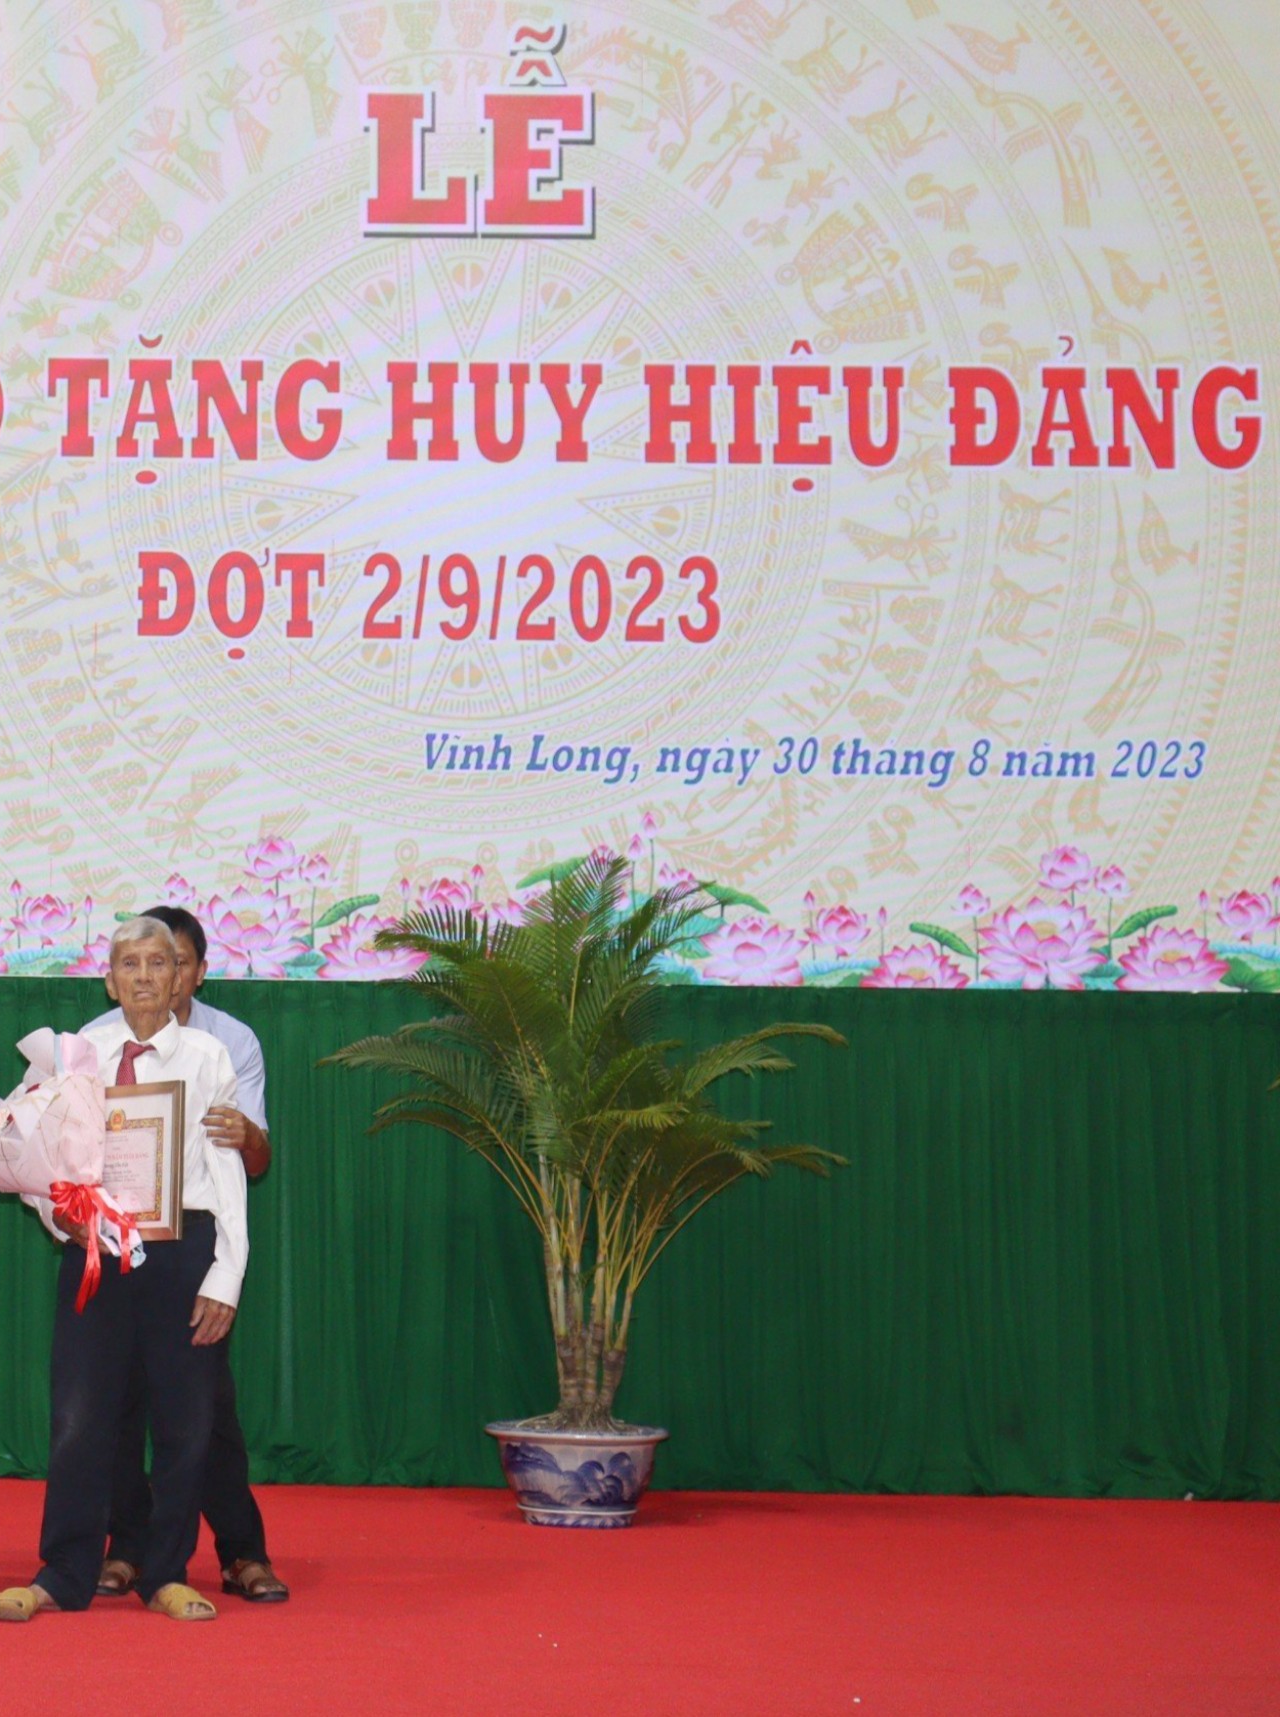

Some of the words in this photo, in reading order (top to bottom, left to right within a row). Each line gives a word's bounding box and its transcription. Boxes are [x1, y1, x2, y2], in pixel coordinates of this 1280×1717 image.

[366, 24, 592, 236] LỄ
[48, 333, 343, 485] TẶNG
[388, 361, 602, 463] HUY
[645, 338, 904, 492] HIỆU
[948, 335, 1263, 470] ĐẢNG
[137, 547, 326, 660] ĐỢT
[363, 553, 722, 643] 2/9/2023
[424, 732, 513, 772] Vĩnh
[524, 733, 640, 786] Long,
[772, 736, 820, 776] 30
[967, 738, 992, 778] 8
[1001, 741, 1096, 779] năm
[1110, 739, 1207, 780] 2023
